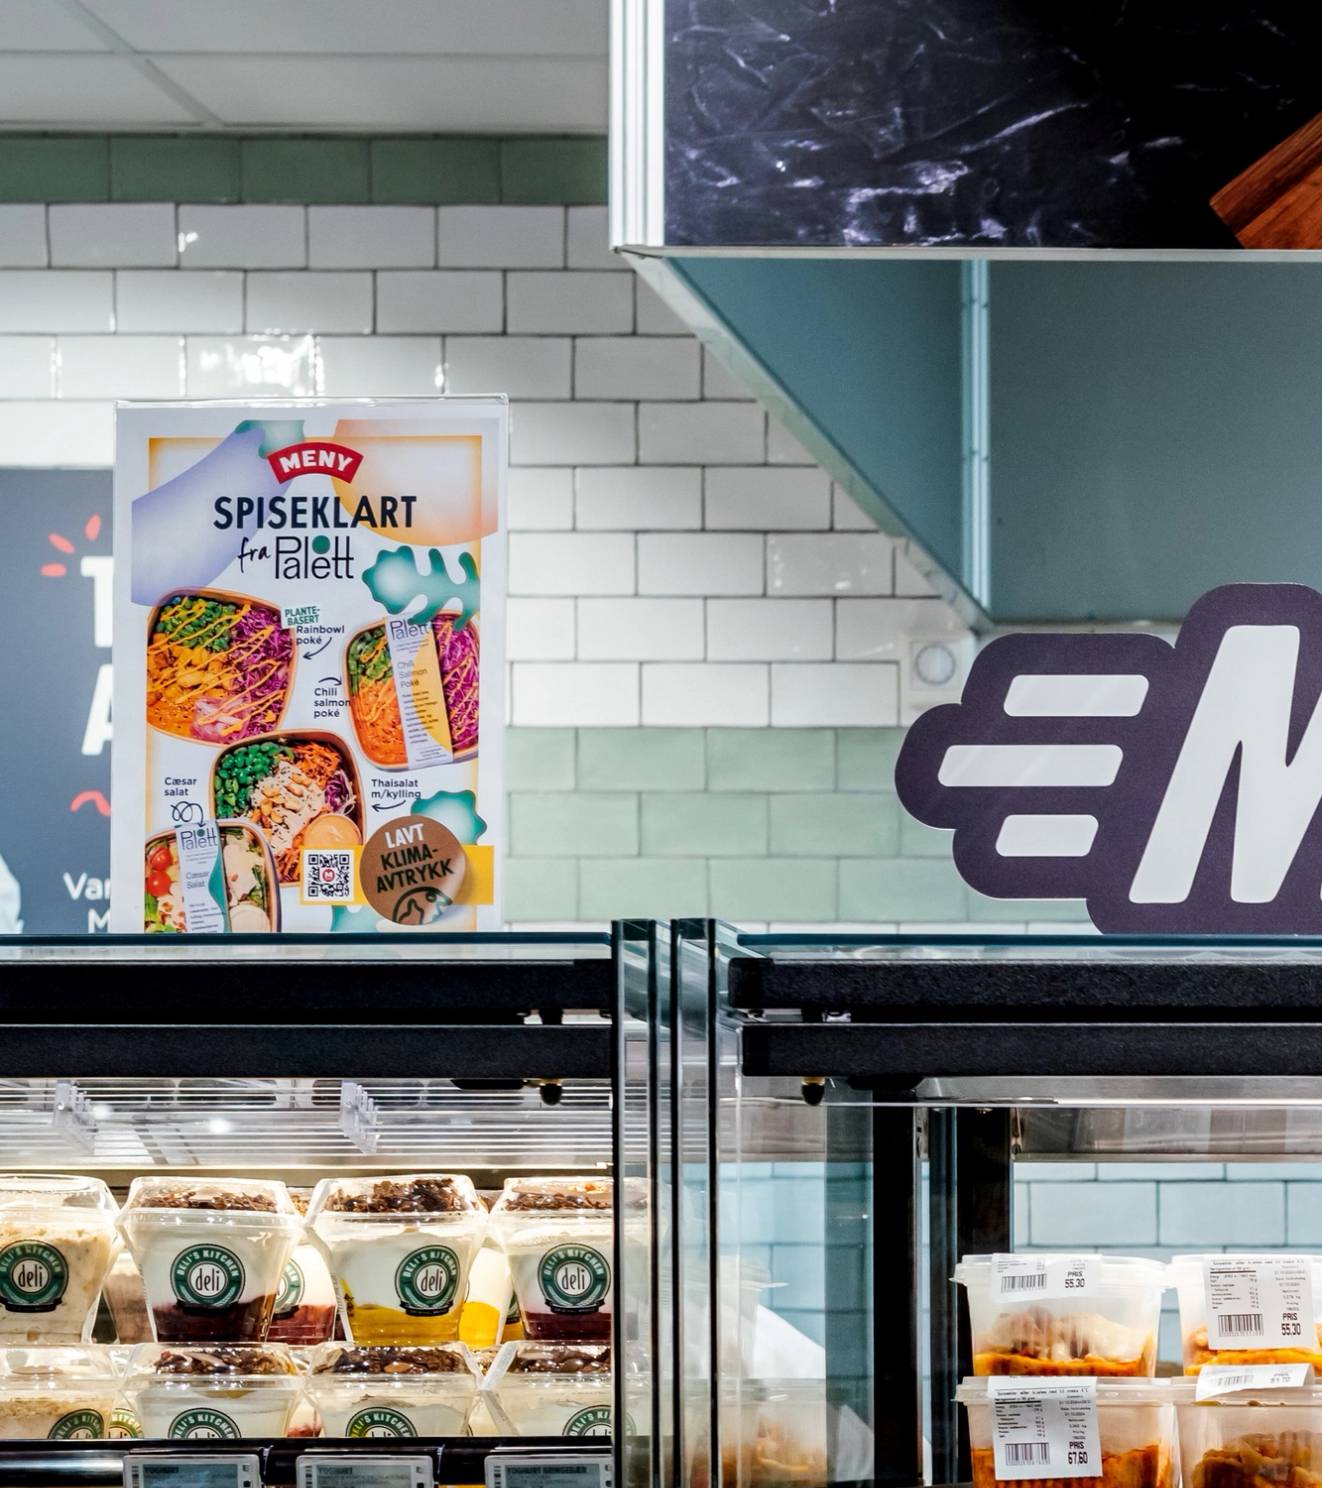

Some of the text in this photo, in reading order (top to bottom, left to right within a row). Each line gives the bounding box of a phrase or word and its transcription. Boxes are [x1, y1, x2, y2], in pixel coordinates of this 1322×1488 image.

[279, 451, 352, 472] MENY
[213, 496, 417, 529] SPISEKLART
[239, 535, 354, 579] fra Palett
[285, 606, 320, 617] PLANTE-
[287, 615, 320, 626] BASERT
[297, 626, 345, 634] Rainbowl
[297, 636, 322, 645] poké
[314, 688, 338, 696] Chili
[314, 699, 350, 707] salmon
[314, 708, 340, 718] poké
[164, 777, 197, 786] Cæsar
[164, 788, 189, 796] salat
[371, 779, 418, 788] Thaisalat
[371, 789, 421, 799] m/kylling
[384, 824, 424, 849] LAVT
[380, 844, 439, 870] KLIMA-
[376, 857, 454, 894] AVTRYKK
[176, 1250, 239, 1278] DELI'S KITCHEN
[402, 1248, 456, 1278] DELI'S KITCHEN
[544, 1248, 603, 1276] DELI'S KITCHEN
[18, 1260, 42, 1288] deli
[195, 1264, 220, 1292] deli
[420, 1269, 444, 1292] deli
[562, 1264, 586, 1290] deli
[1283, 1313, 1298, 1321] PRIS
